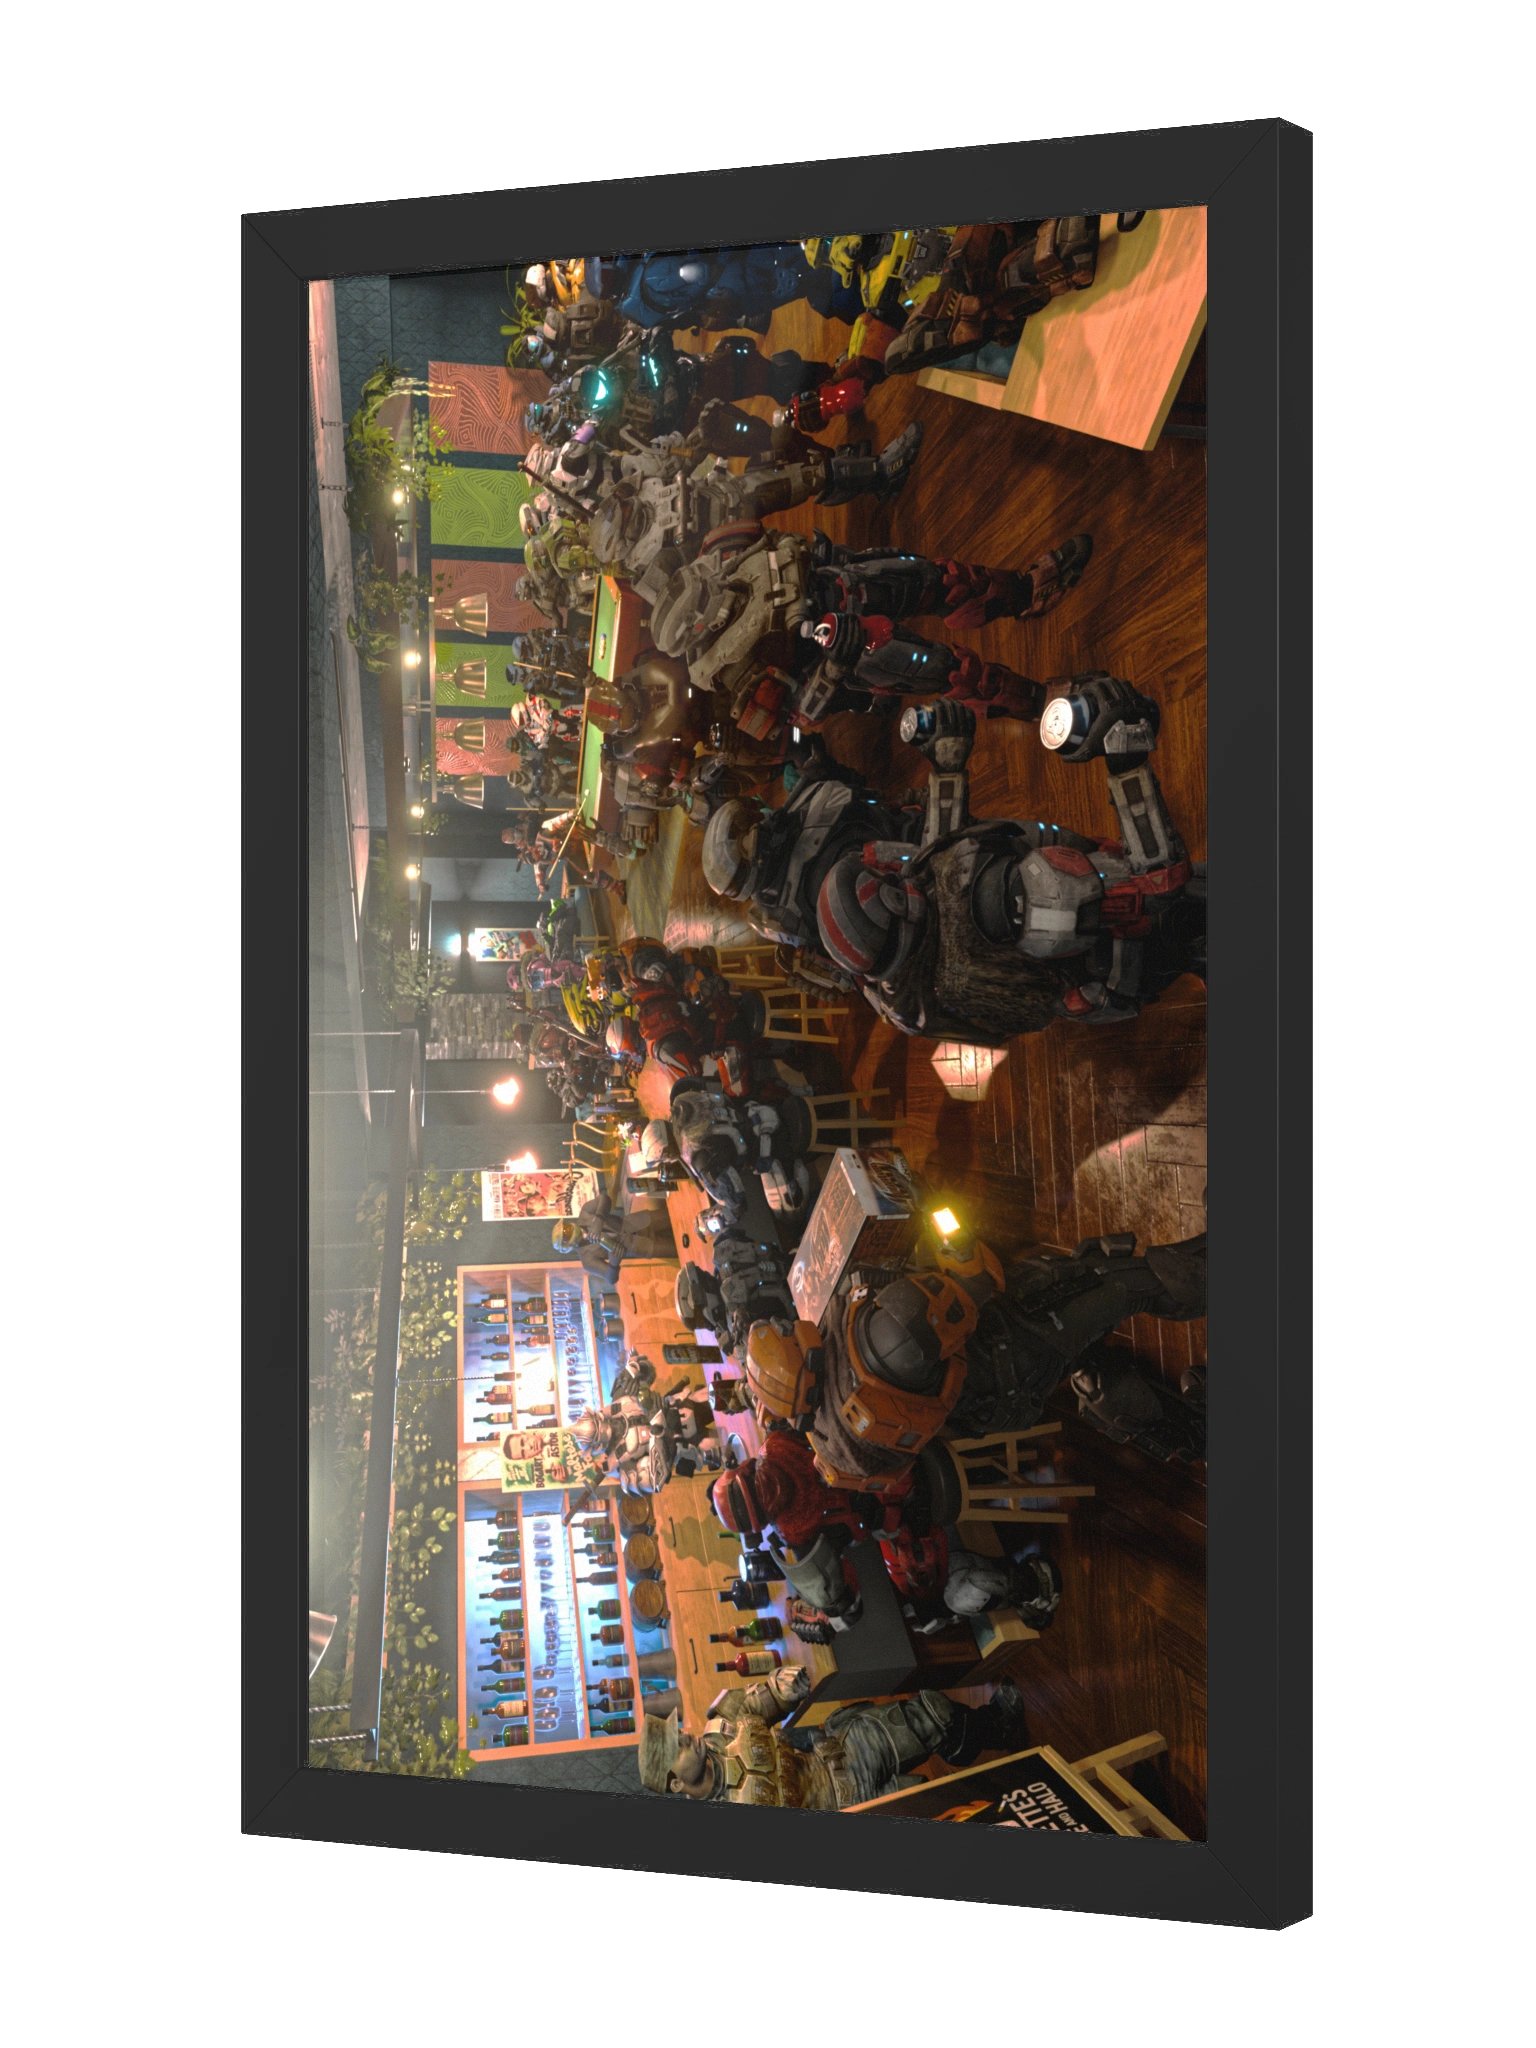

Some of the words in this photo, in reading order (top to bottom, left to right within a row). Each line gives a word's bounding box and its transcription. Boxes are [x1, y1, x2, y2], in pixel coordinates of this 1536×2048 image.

[549, 1432, 560, 1458] ASTOR
[562, 1435, 586, 1482] Maltese
[534, 1458, 545, 1488] BOGART
[1027, 1782, 1068, 1814] HALO
[1059, 1812, 1077, 1826] AND
